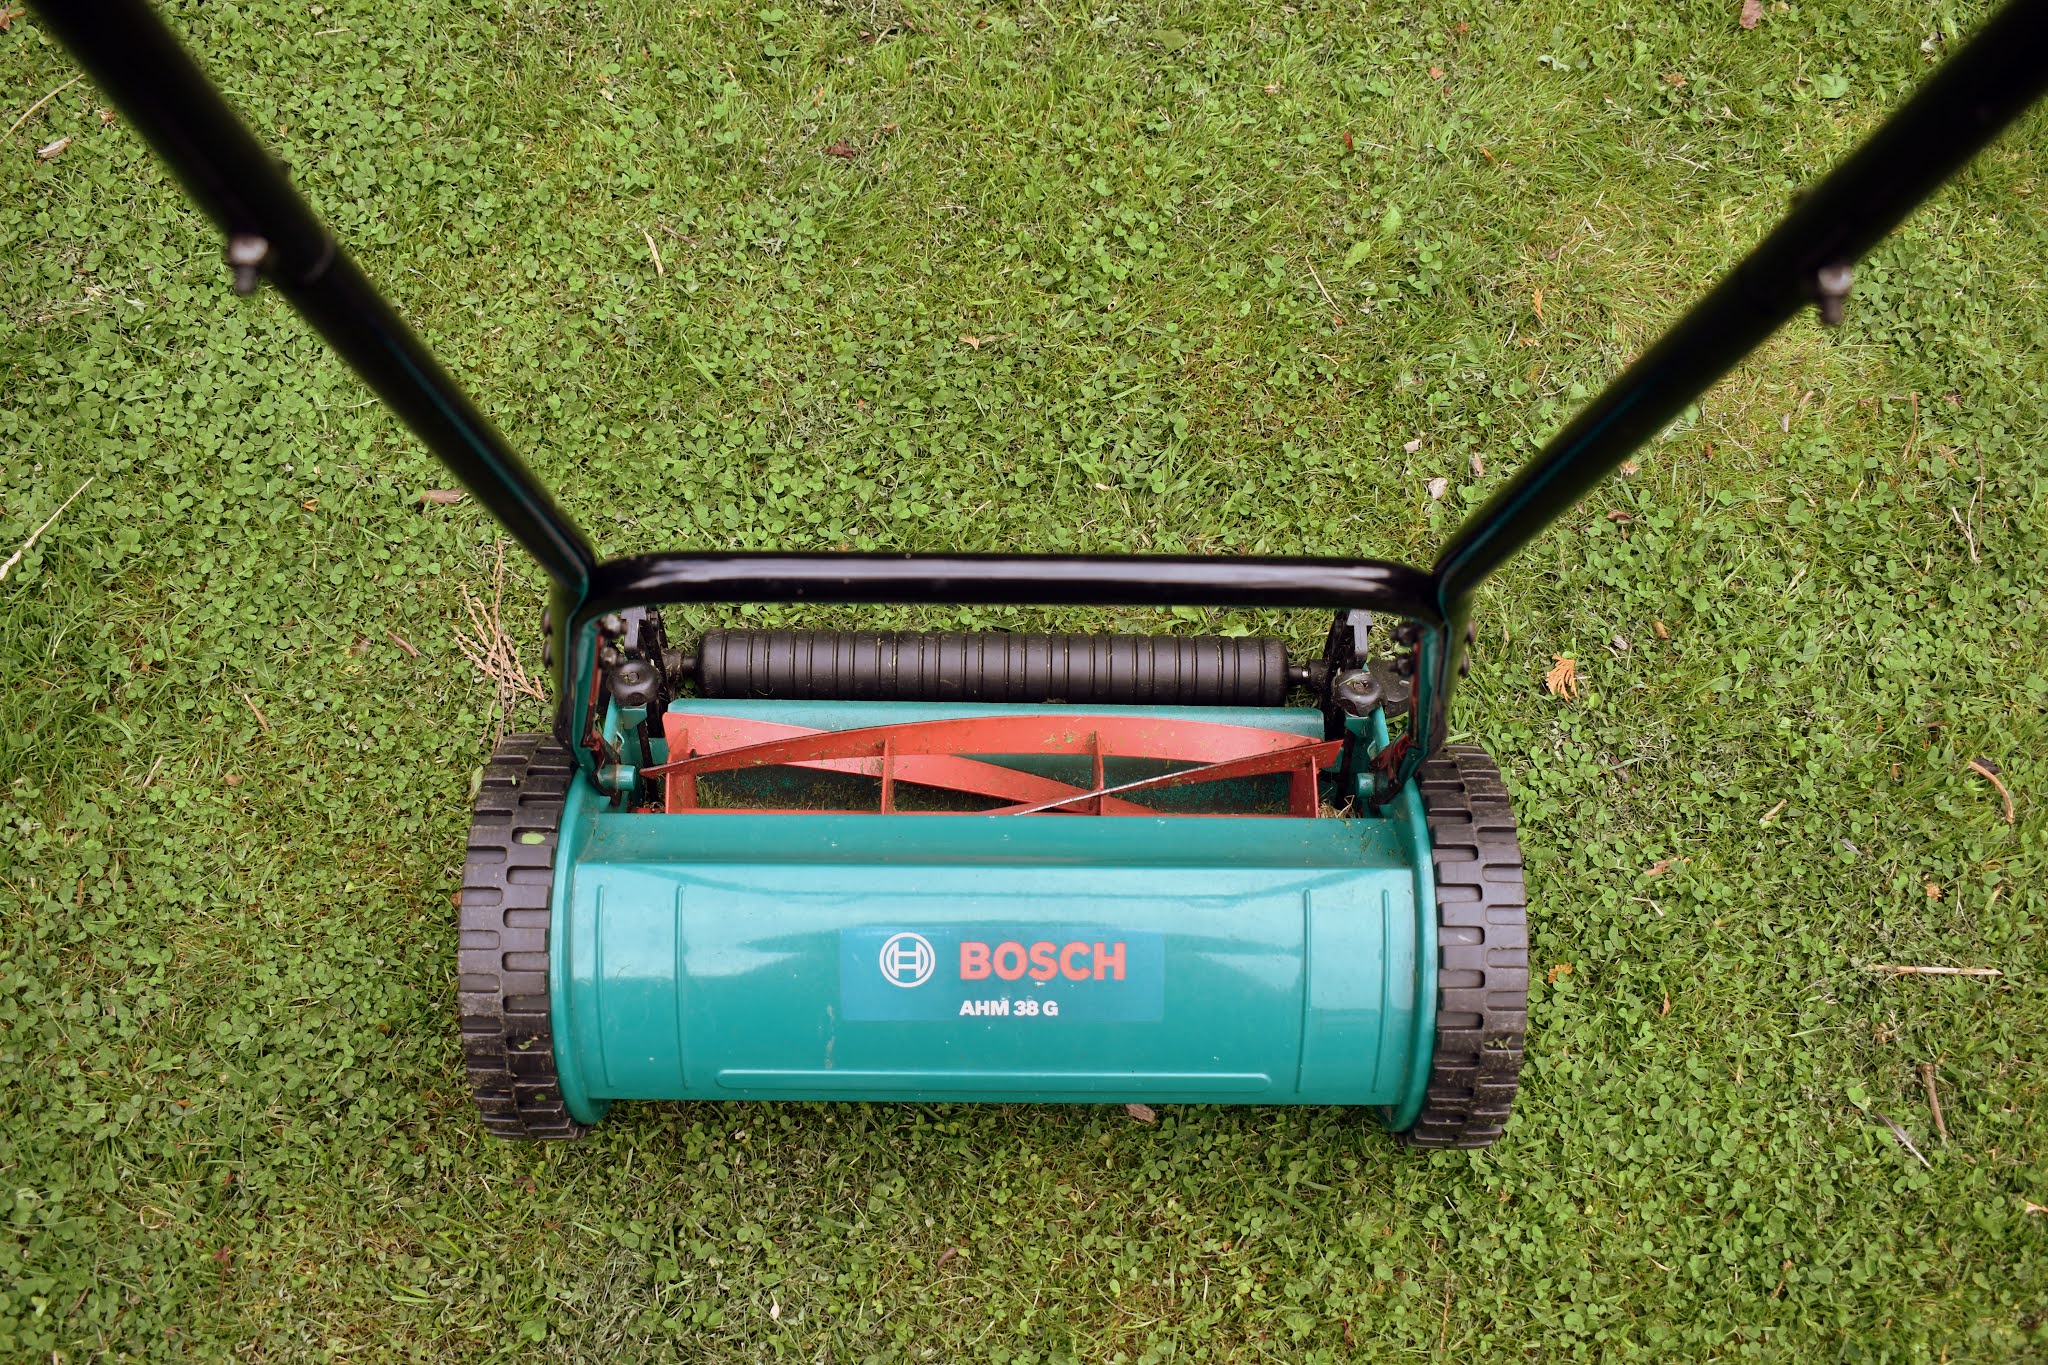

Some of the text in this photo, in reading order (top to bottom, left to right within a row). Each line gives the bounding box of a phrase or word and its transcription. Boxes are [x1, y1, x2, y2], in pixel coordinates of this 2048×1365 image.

[959, 941, 1126, 981] BOSCH
[959, 1000, 1059, 1016] AHM 38 G
